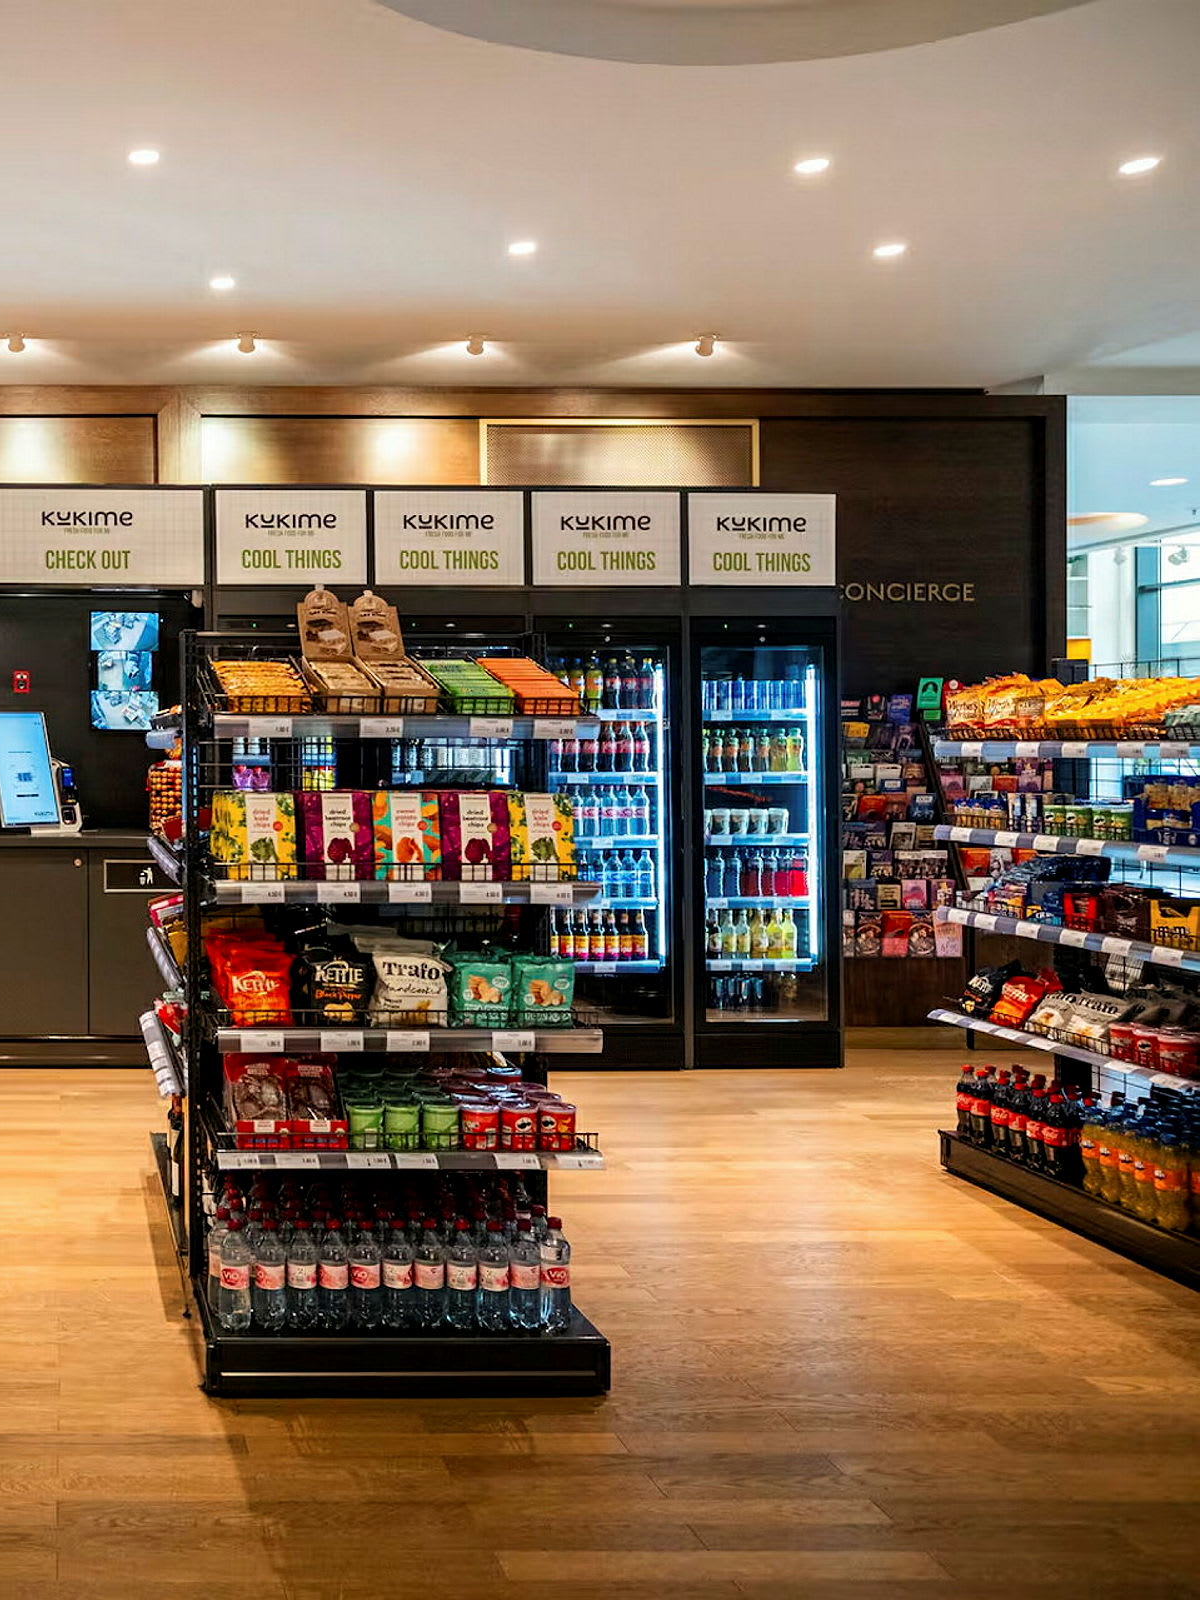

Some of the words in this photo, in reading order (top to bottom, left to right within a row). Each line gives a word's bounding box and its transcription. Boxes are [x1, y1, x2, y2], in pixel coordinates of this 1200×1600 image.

[45, 550, 97, 569] CHECK
[102, 550, 131, 569] OUT
[241, 549, 281, 569] COOL
[285, 549, 342, 569] THINGS
[400, 550, 439, 570] COOL
[442, 550, 499, 570] THINGS
[557, 551, 596, 570] COOL
[600, 551, 656, 570] THINGS
[713, 552, 751, 572] COOL
[755, 552, 811, 572] THINGS
[315, 961, 364, 984] KETTLE
[382, 962, 440, 980] Trafo
